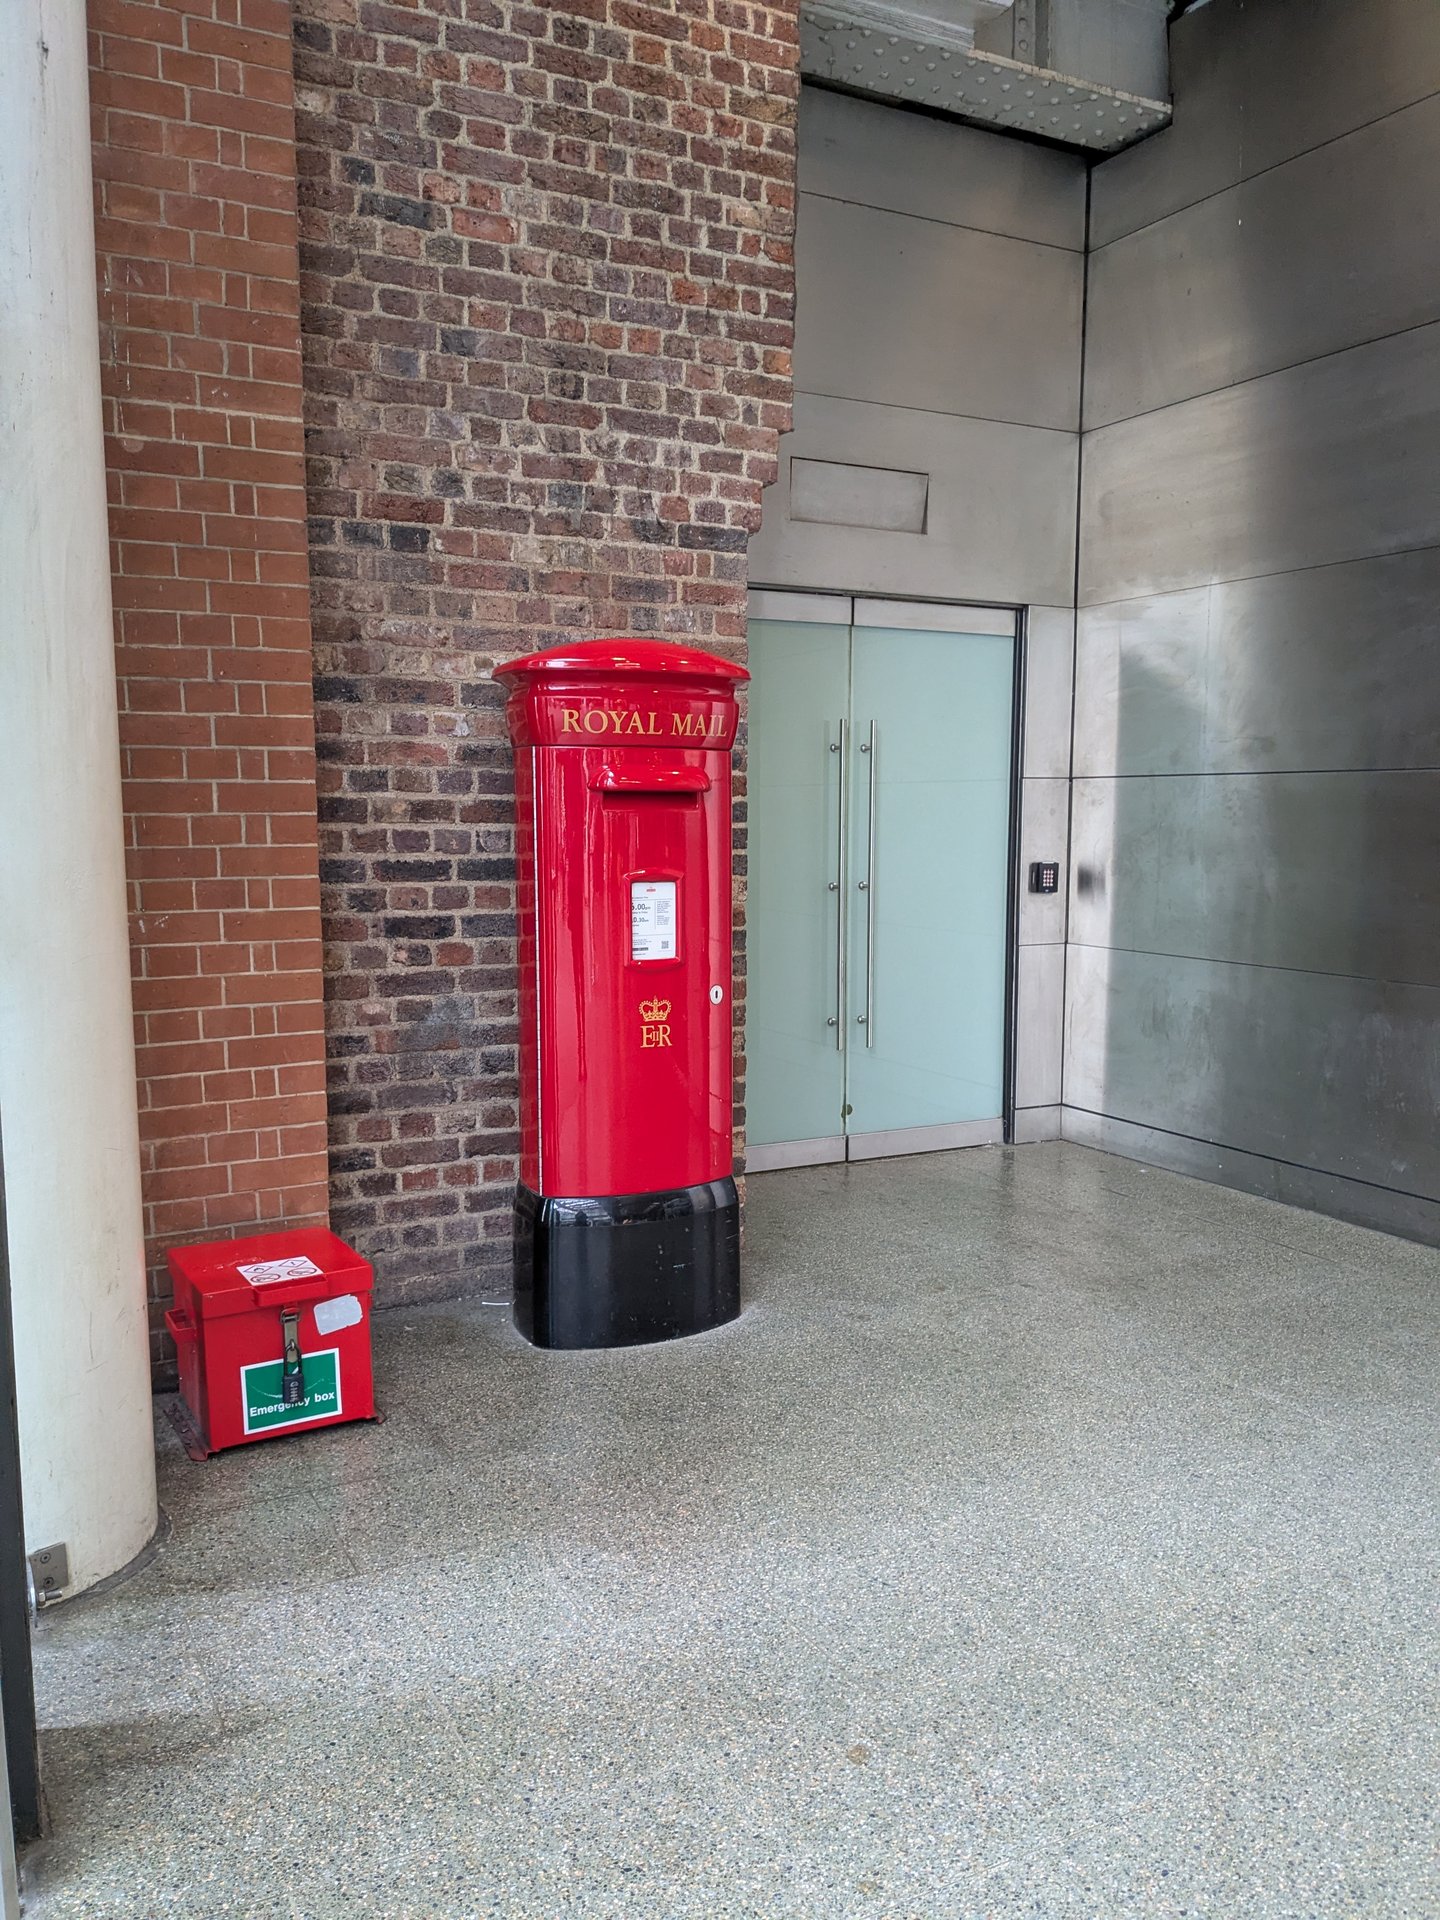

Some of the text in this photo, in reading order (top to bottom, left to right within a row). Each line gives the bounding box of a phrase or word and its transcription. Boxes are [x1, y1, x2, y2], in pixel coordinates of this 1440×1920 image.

[561, 708, 727, 737] ROYAL MAIL
[314, 1391, 335, 1403] box
